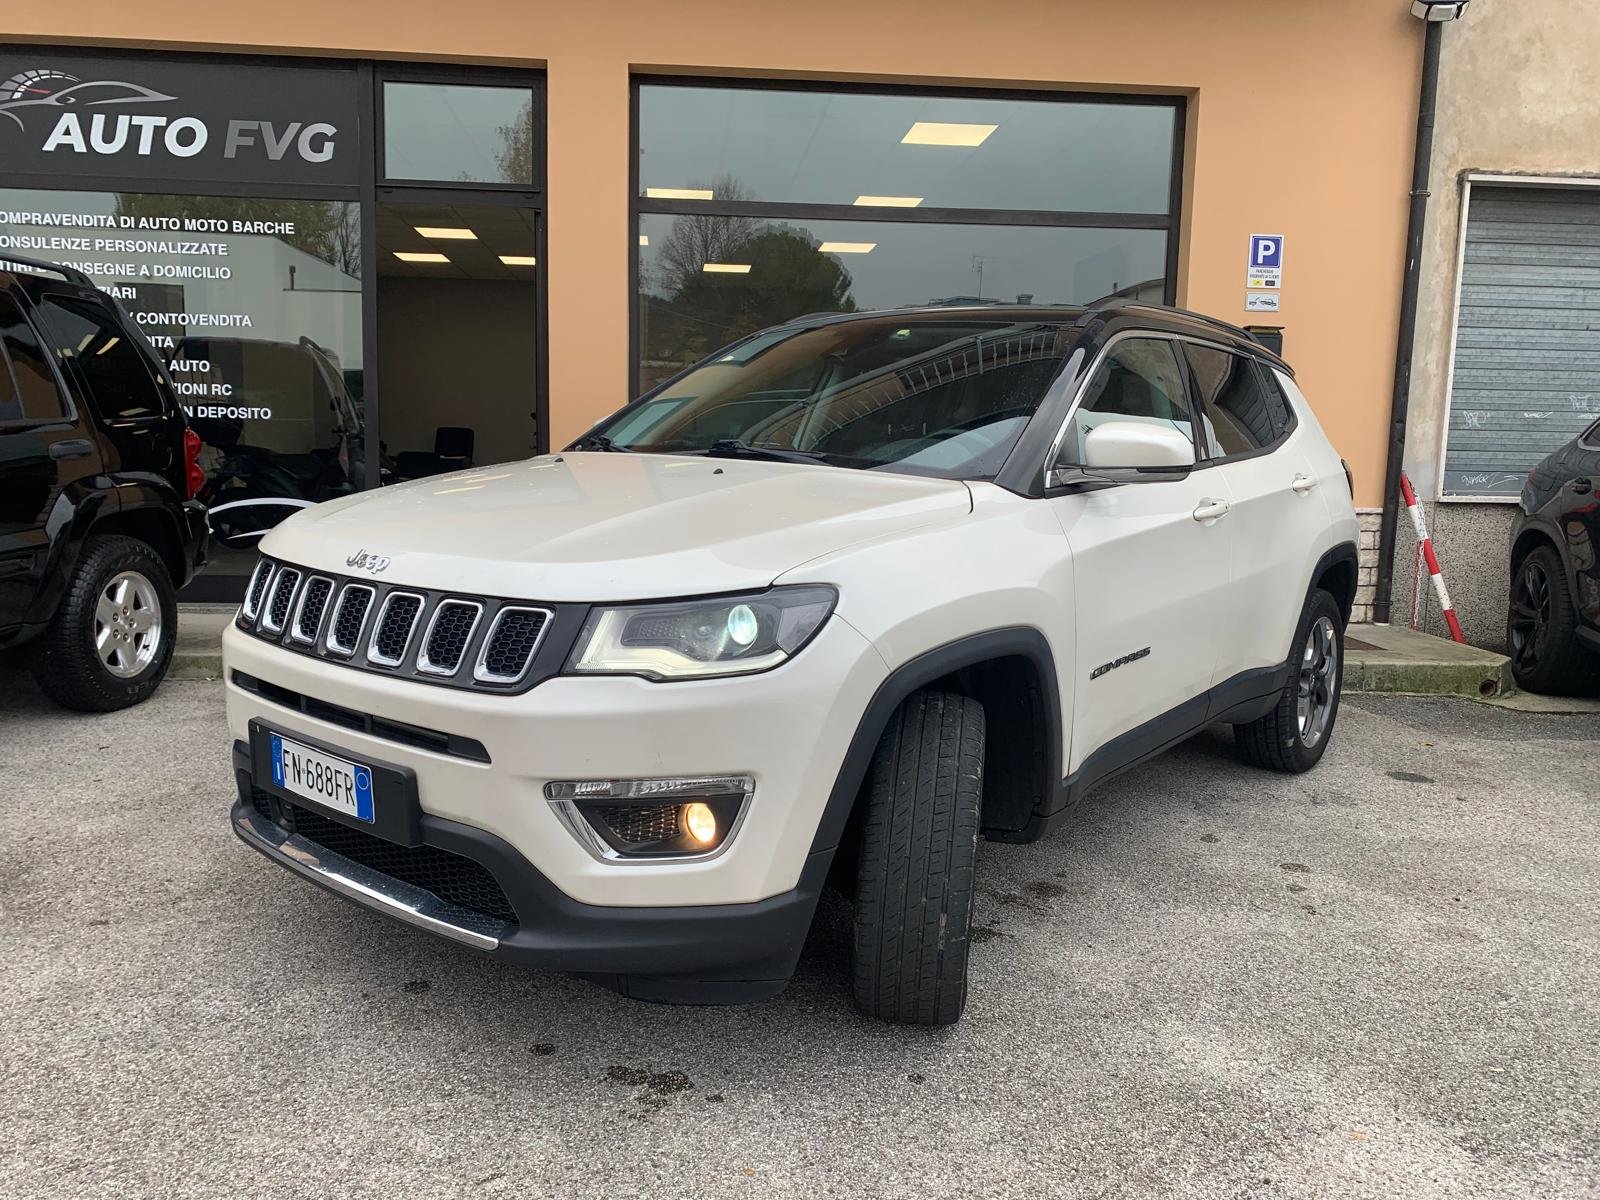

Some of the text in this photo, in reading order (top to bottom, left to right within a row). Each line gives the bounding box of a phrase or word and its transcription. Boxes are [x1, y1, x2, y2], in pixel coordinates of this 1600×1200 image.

[42, 112, 338, 163] AUTO FVG
[120, 216, 135, 228] DI
[139, 217, 180, 230] AUTO
[184, 218, 228, 232] MOTO
[233, 220, 295, 234] BARCHE
[95, 239, 228, 256] PERSONALIZZATE
[1257, 239, 1276, 264] P
[52, 261, 136, 277] NSEGNE
[139, 264, 150, 277] A
[153, 264, 231, 279] DOMICILIO
[136, 312, 252, 327] CONTOVENDITA
[169, 359, 210, 372] AUTO
[173, 382, 232, 396] IONI RC
[197, 406, 272, 420] DEPOSITO
[346, 548, 391, 575] Jeep
[1089, 646, 1151, 680] COMPASS
